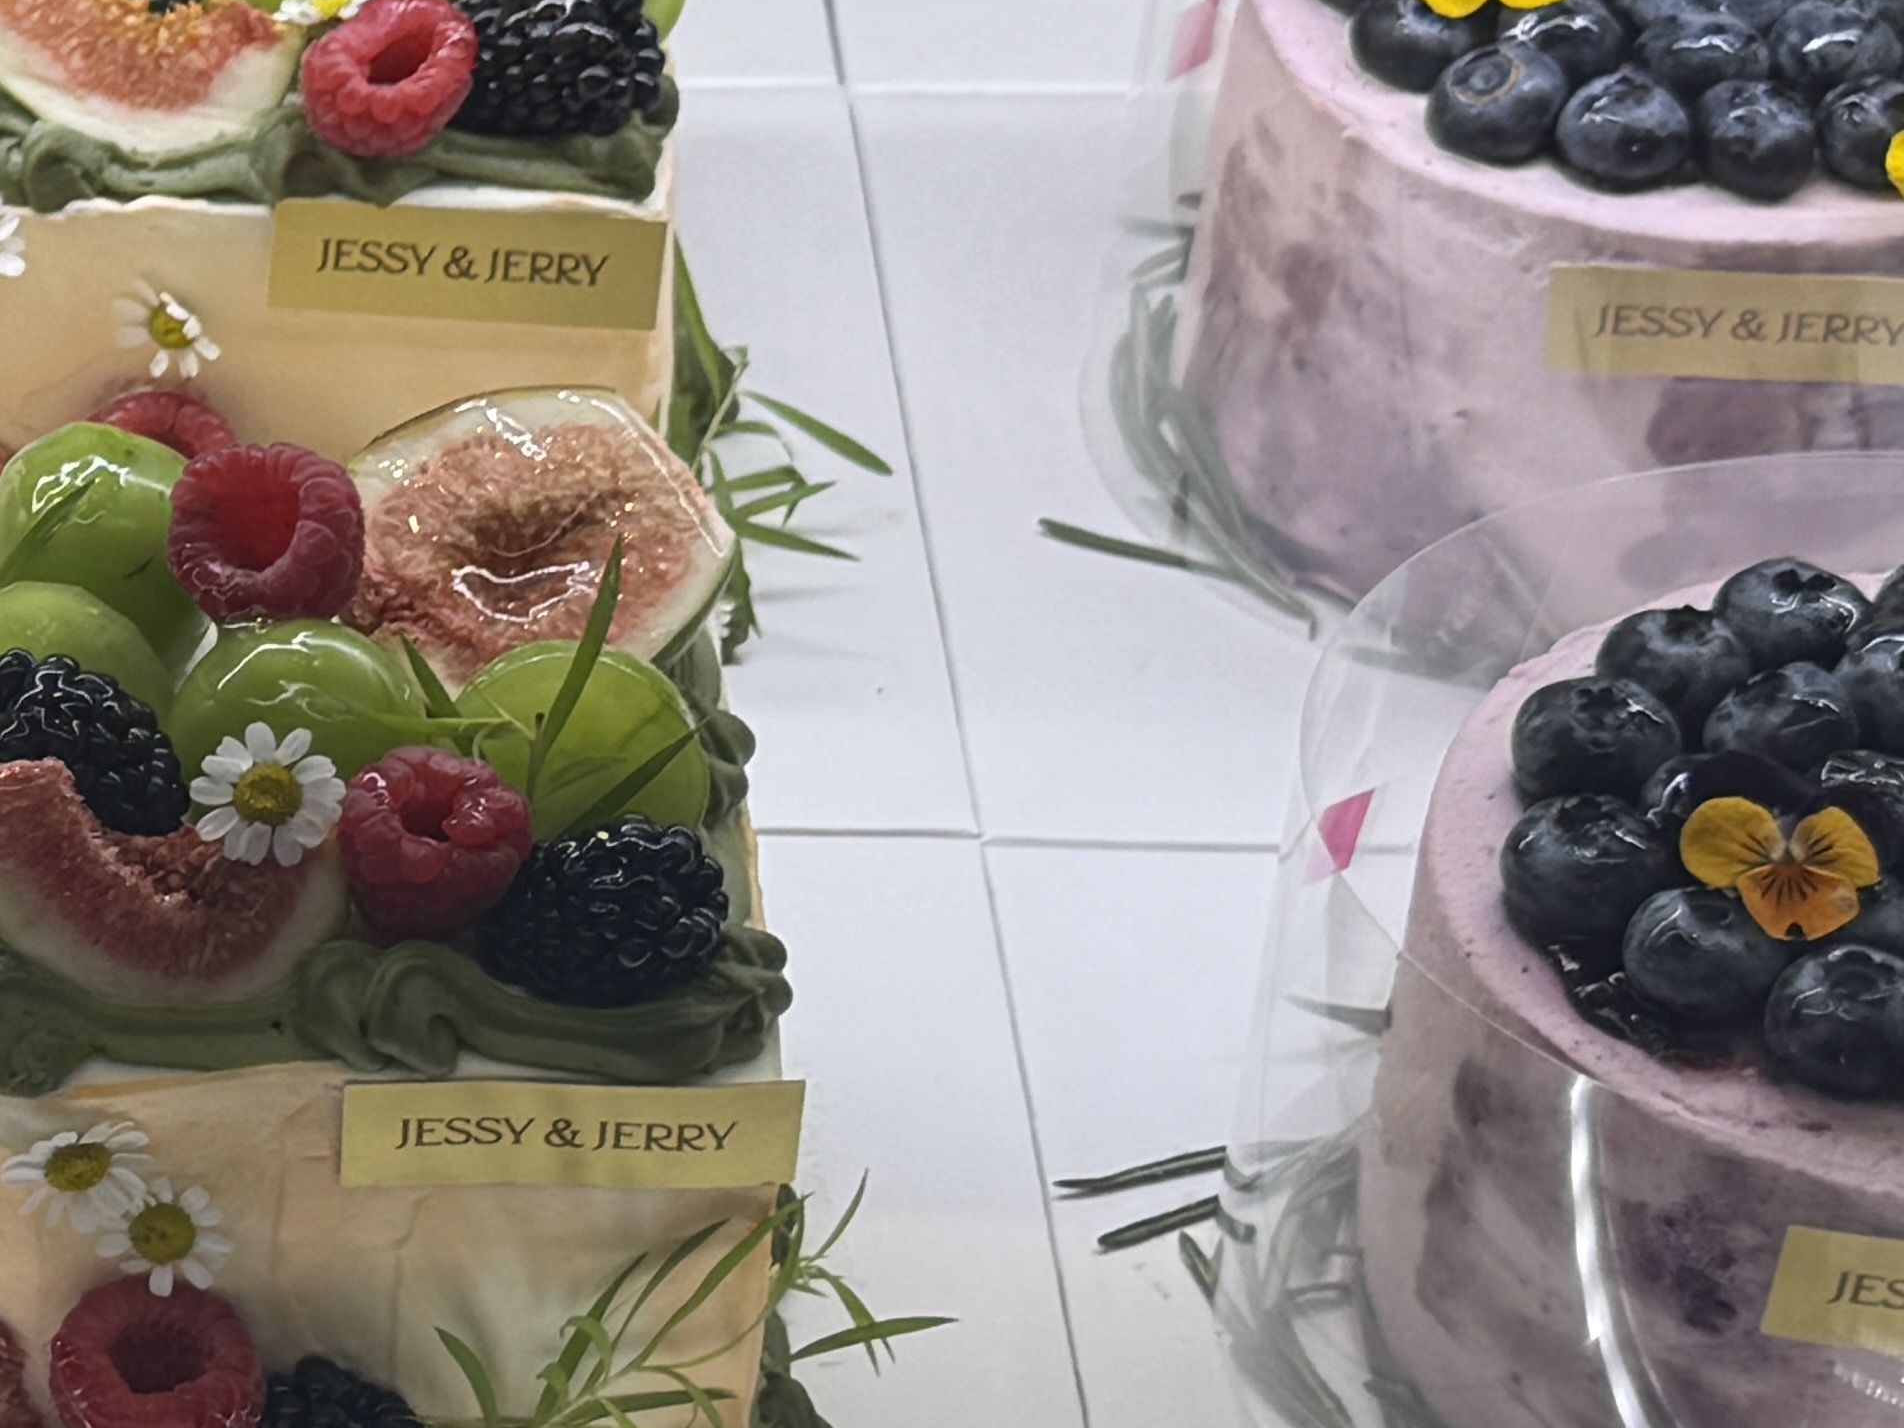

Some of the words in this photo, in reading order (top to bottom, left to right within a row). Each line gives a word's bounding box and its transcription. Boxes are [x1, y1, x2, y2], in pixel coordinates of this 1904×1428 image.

[316, 238, 439, 274] JESSY
[443, 246, 479, 281] &
[484, 248, 610, 287] JERRY
[1594, 303, 1725, 339] JESSY
[1730, 308, 1767, 342] &
[1776, 312, 1904, 348] JERRY
[395, 1116, 535, 1150] JESSY
[544, 1118, 584, 1149] &
[591, 1120, 739, 1153] JERRY
